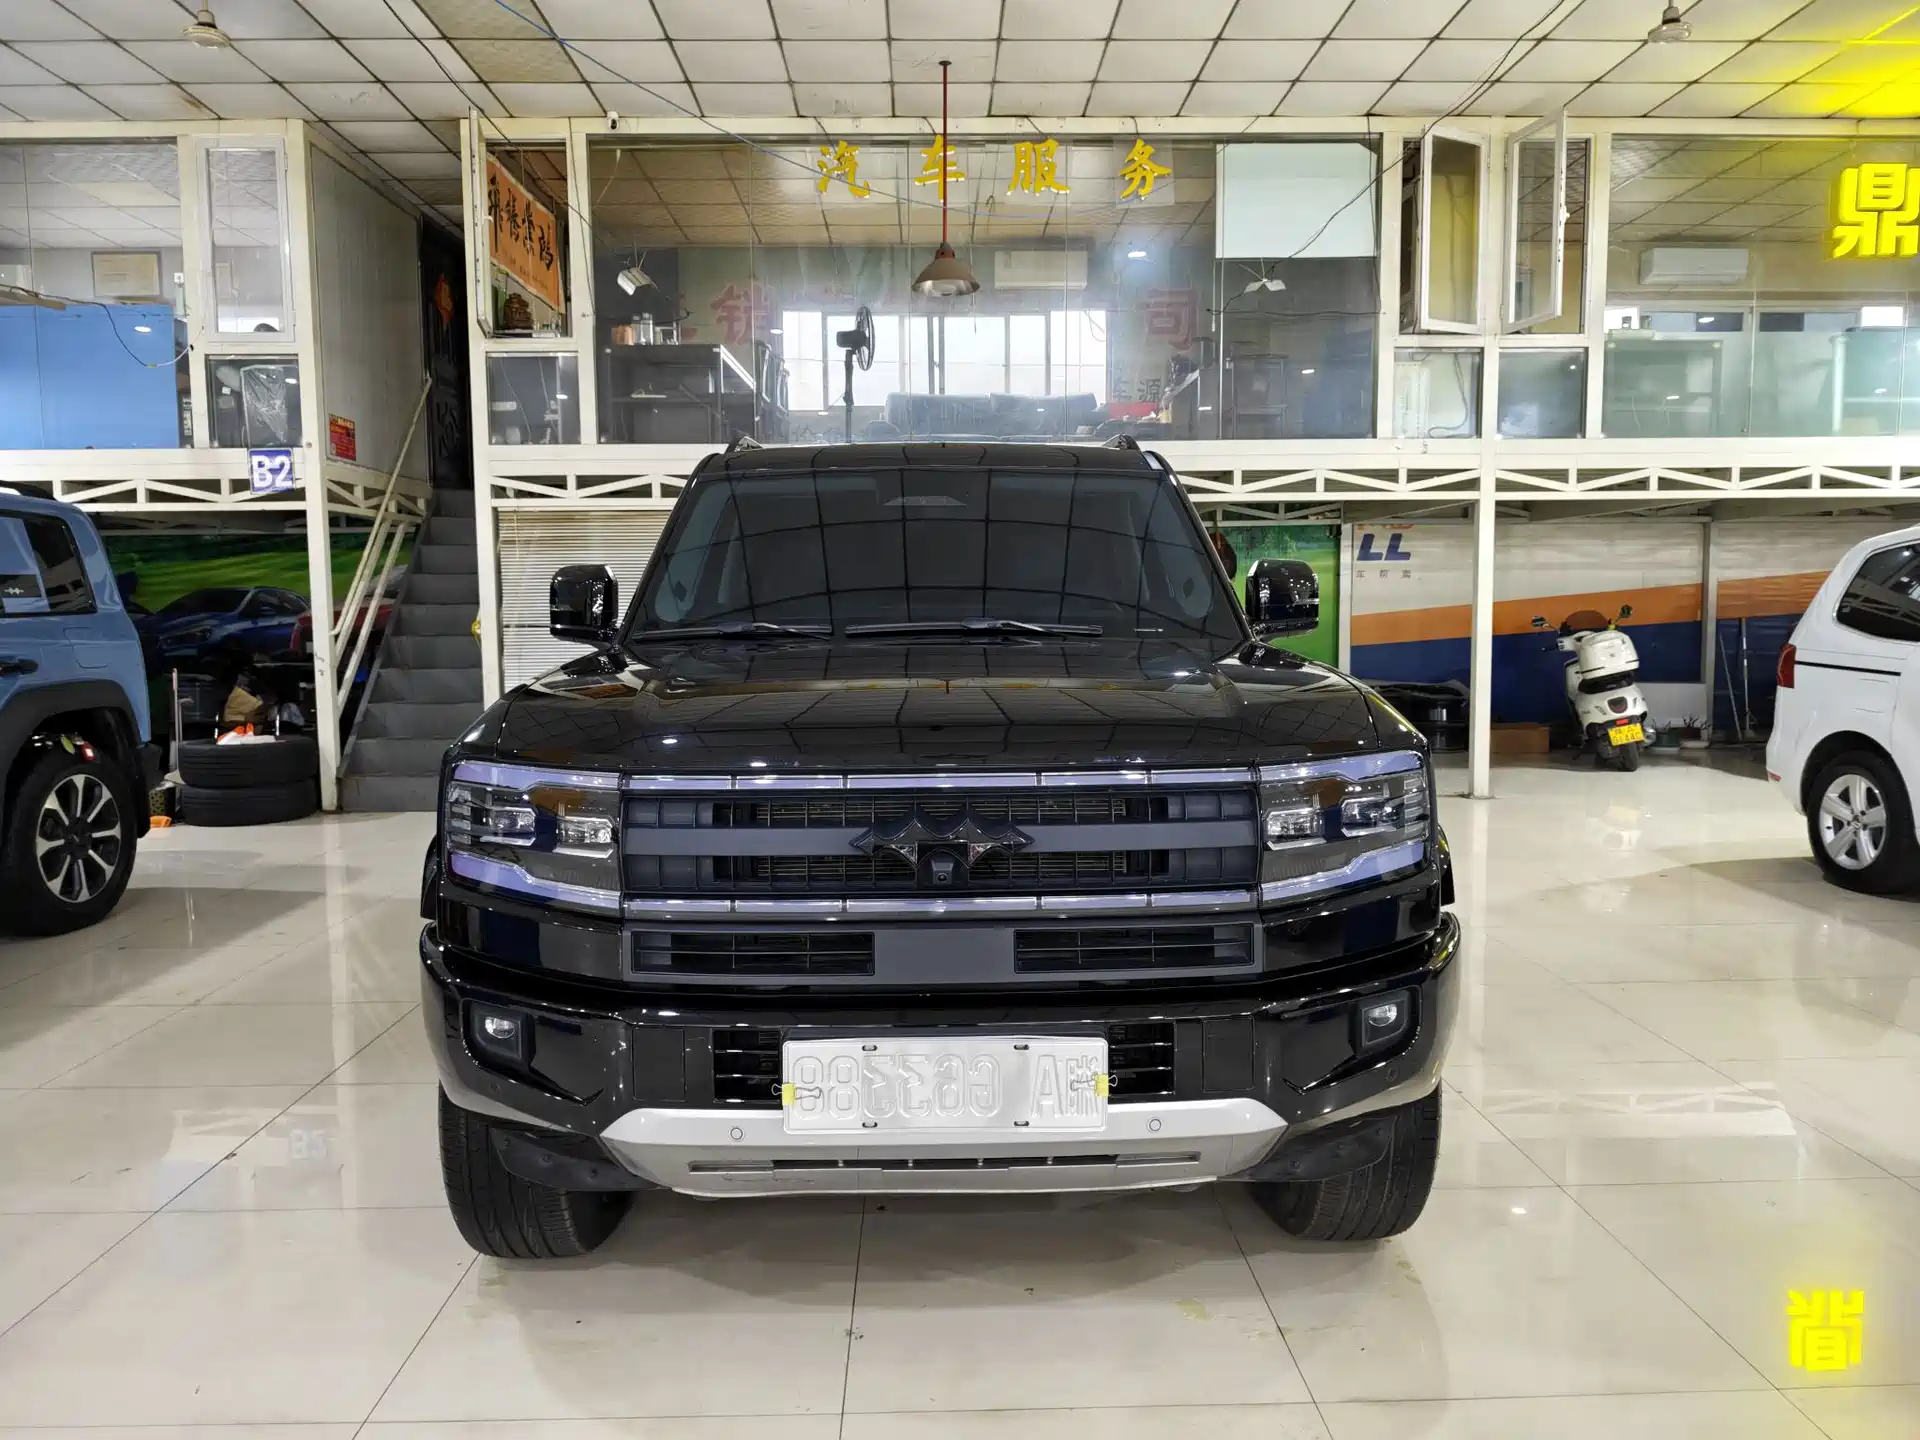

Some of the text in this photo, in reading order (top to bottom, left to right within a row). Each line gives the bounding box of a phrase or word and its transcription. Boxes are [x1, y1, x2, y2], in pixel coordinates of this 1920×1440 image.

[816, 135, 1172, 201] 汽车服务
[1832, 163, 1920, 259] 鼎
[252, 455, 293, 487] B2
[1357, 533, 1411, 561] LL
